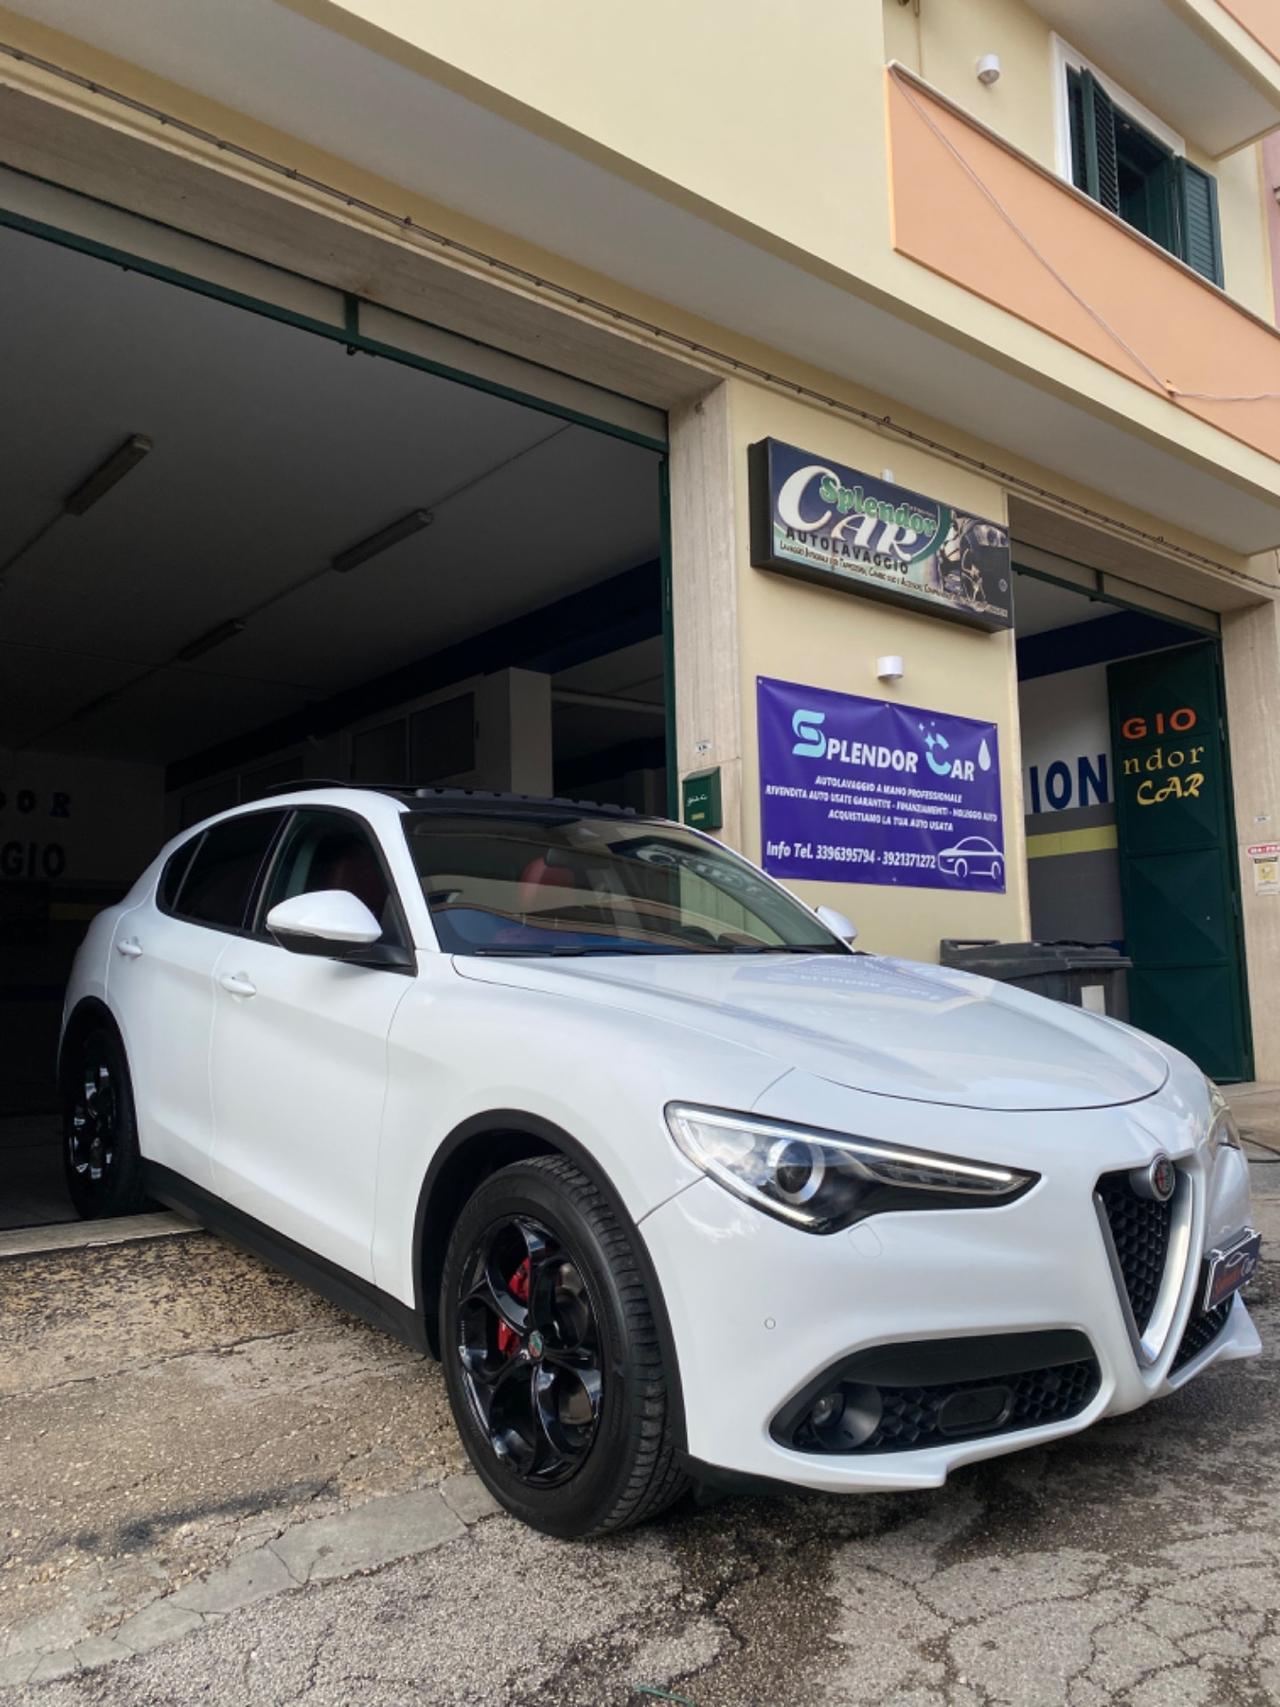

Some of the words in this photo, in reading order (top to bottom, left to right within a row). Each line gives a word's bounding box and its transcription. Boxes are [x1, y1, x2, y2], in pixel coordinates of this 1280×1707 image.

[777, 465, 918, 561] CAR
[818, 475, 937, 536] Splendor
[785, 526, 909, 574] AUTOLAVAGGIO
[1122, 707, 1198, 740] GIO
[792, 708, 918, 773] SPLENDOR
[924, 731, 975, 781] CAR
[1123, 745, 1206, 775] ndor
[765, 784, 807, 798] RIVENDITA
[809, 790, 829, 801] AUTO
[830, 793, 852, 805] USATE
[853, 795, 891, 809] GARANTITE
[897, 800, 948, 815] FINANZIAMENTI
[815, 775, 875, 792] AUTOLAVAGGIO
[876, 784, 882, 792] A
[884, 785, 906, 796] MANO
[907, 788, 962, 803] PROFESSIONALE
[1029, 753, 1109, 813] ION
[1136, 772, 1205, 806] CAR
[828, 809, 881, 823] ACQUISTIAMO
[882, 815, 891, 825] LA
[893, 816, 908, 826] TUA
[909, 818, 928, 828] AUTO
[929, 820, 954, 832] USATA
[766, 841, 791, 859] Info
[794, 842, 813, 859] Tel.
[816, 844, 876, 863] 3396395794
[882, 851, 937, 869] 3921371272
